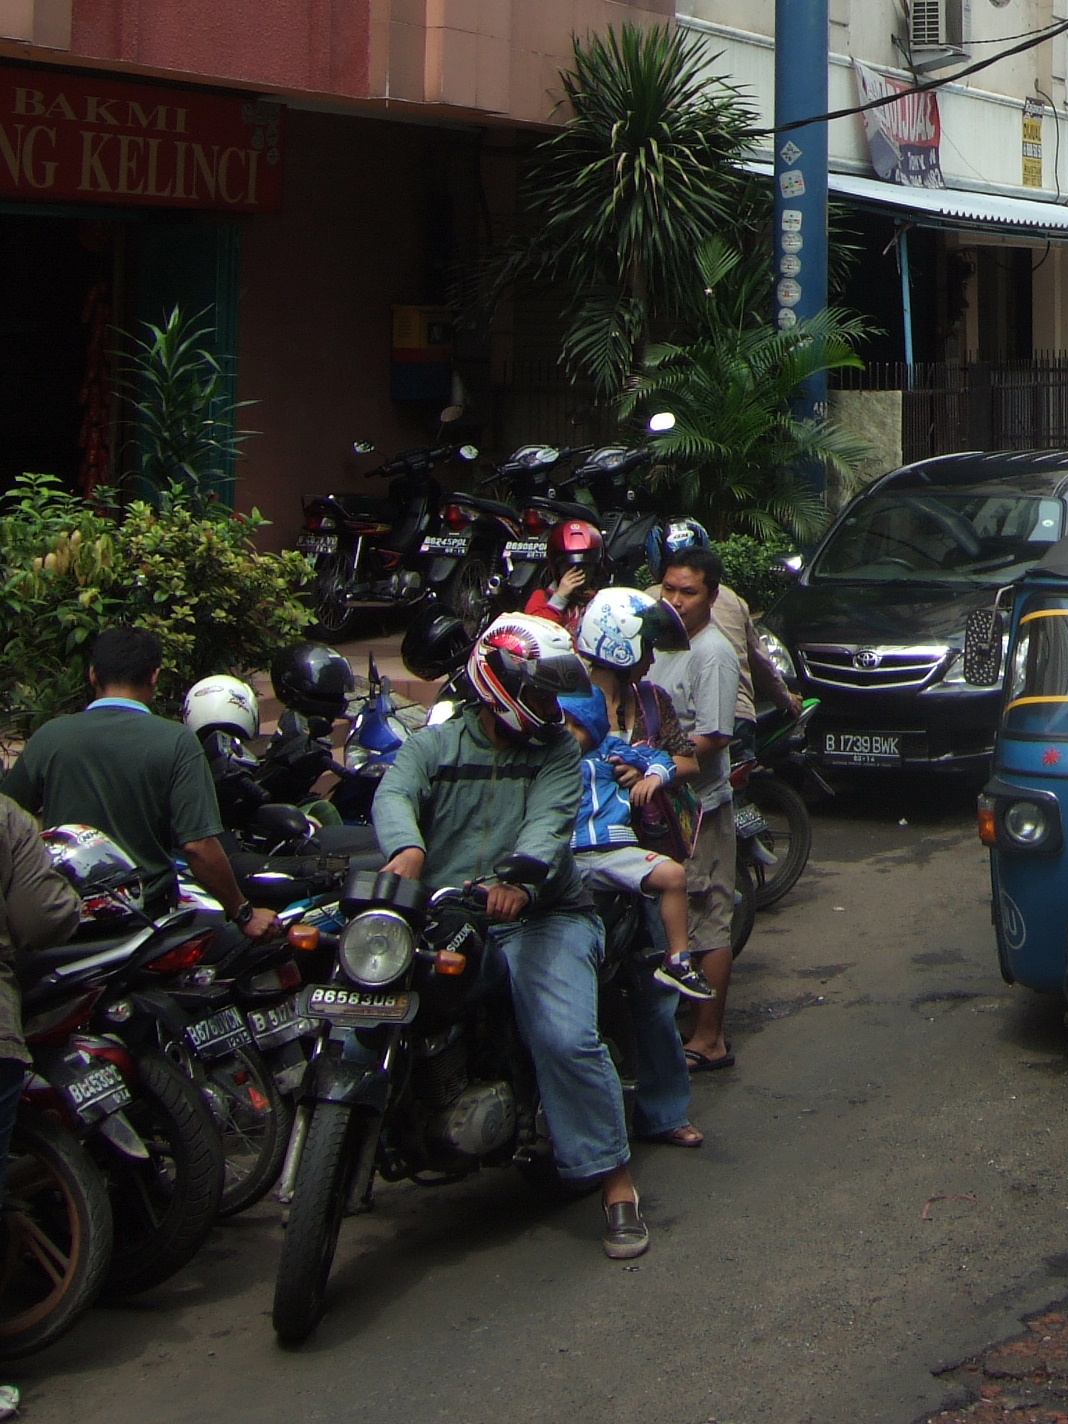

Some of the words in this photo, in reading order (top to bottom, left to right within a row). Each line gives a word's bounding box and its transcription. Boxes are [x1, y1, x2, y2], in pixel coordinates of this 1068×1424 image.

[12, 87, 189, 133] BAKMI
[77, 131, 262, 205] KELINCI
[826, 734, 835, 751] B
[840, 735, 870, 753] 1739
[872, 736, 899, 754] BWK
